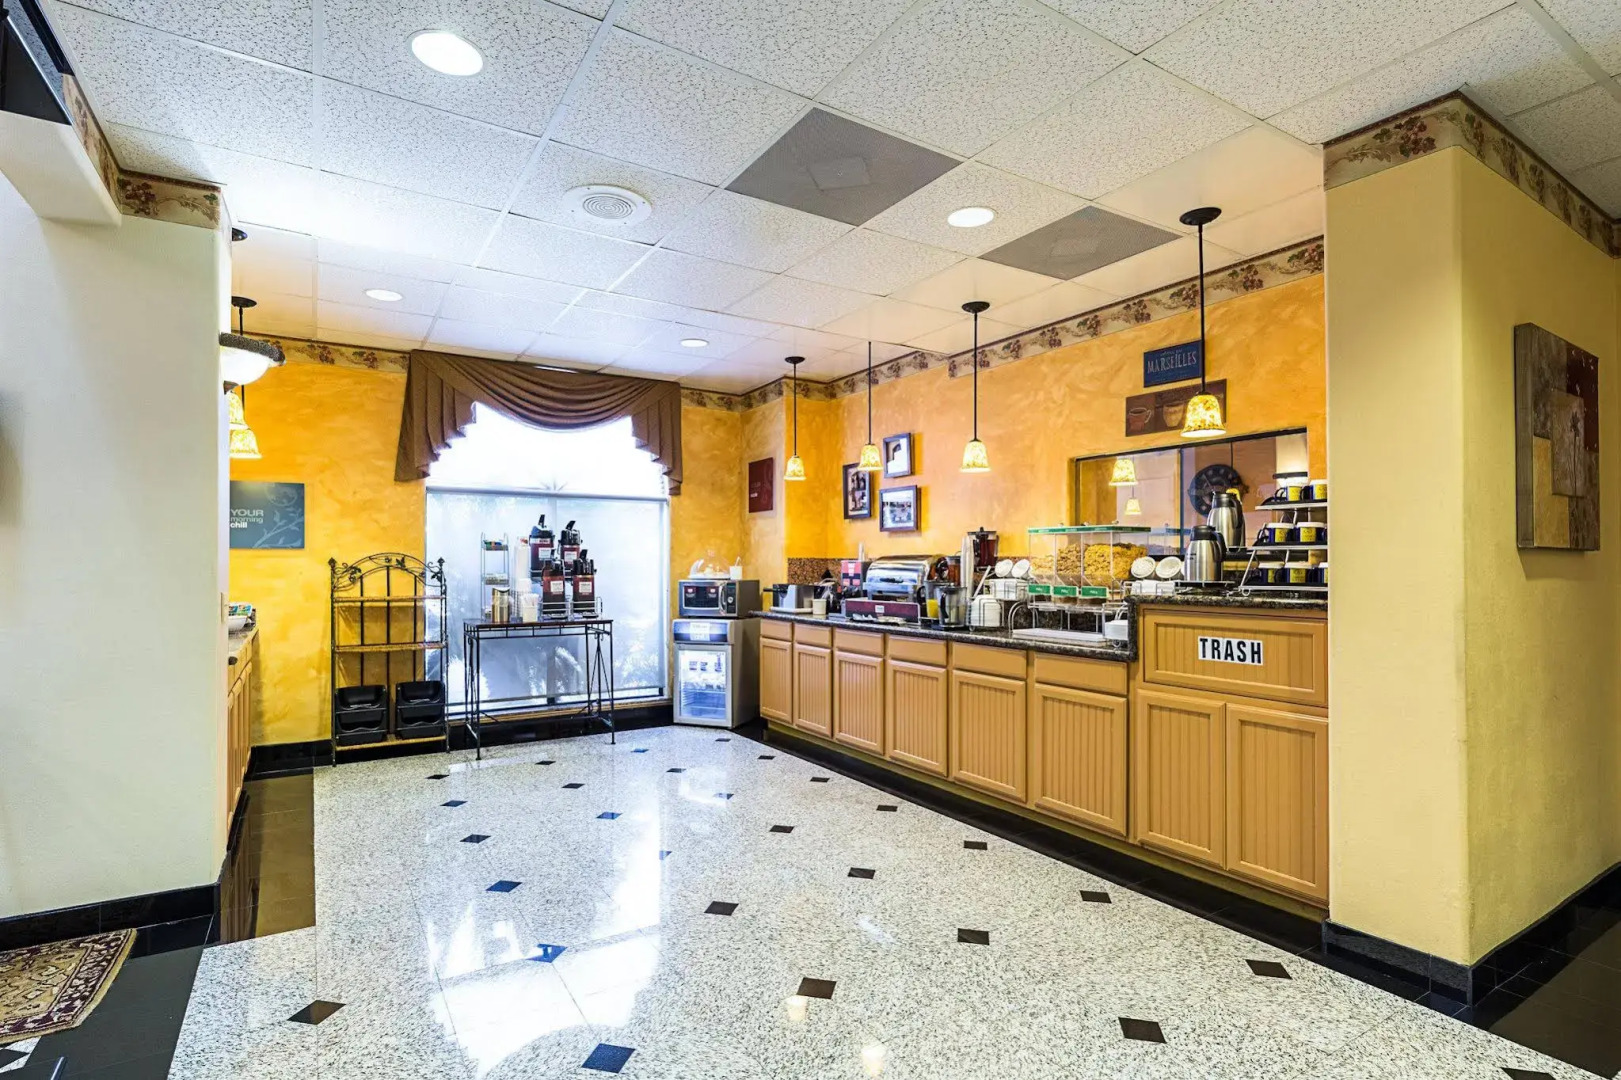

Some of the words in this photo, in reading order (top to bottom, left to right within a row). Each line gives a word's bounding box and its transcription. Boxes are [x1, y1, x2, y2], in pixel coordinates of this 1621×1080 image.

[230, 509, 264, 517] YOUR
[230, 516, 264, 524] morning
[230, 521, 248, 529] chill
[1199, 638, 1262, 664] TRASH
